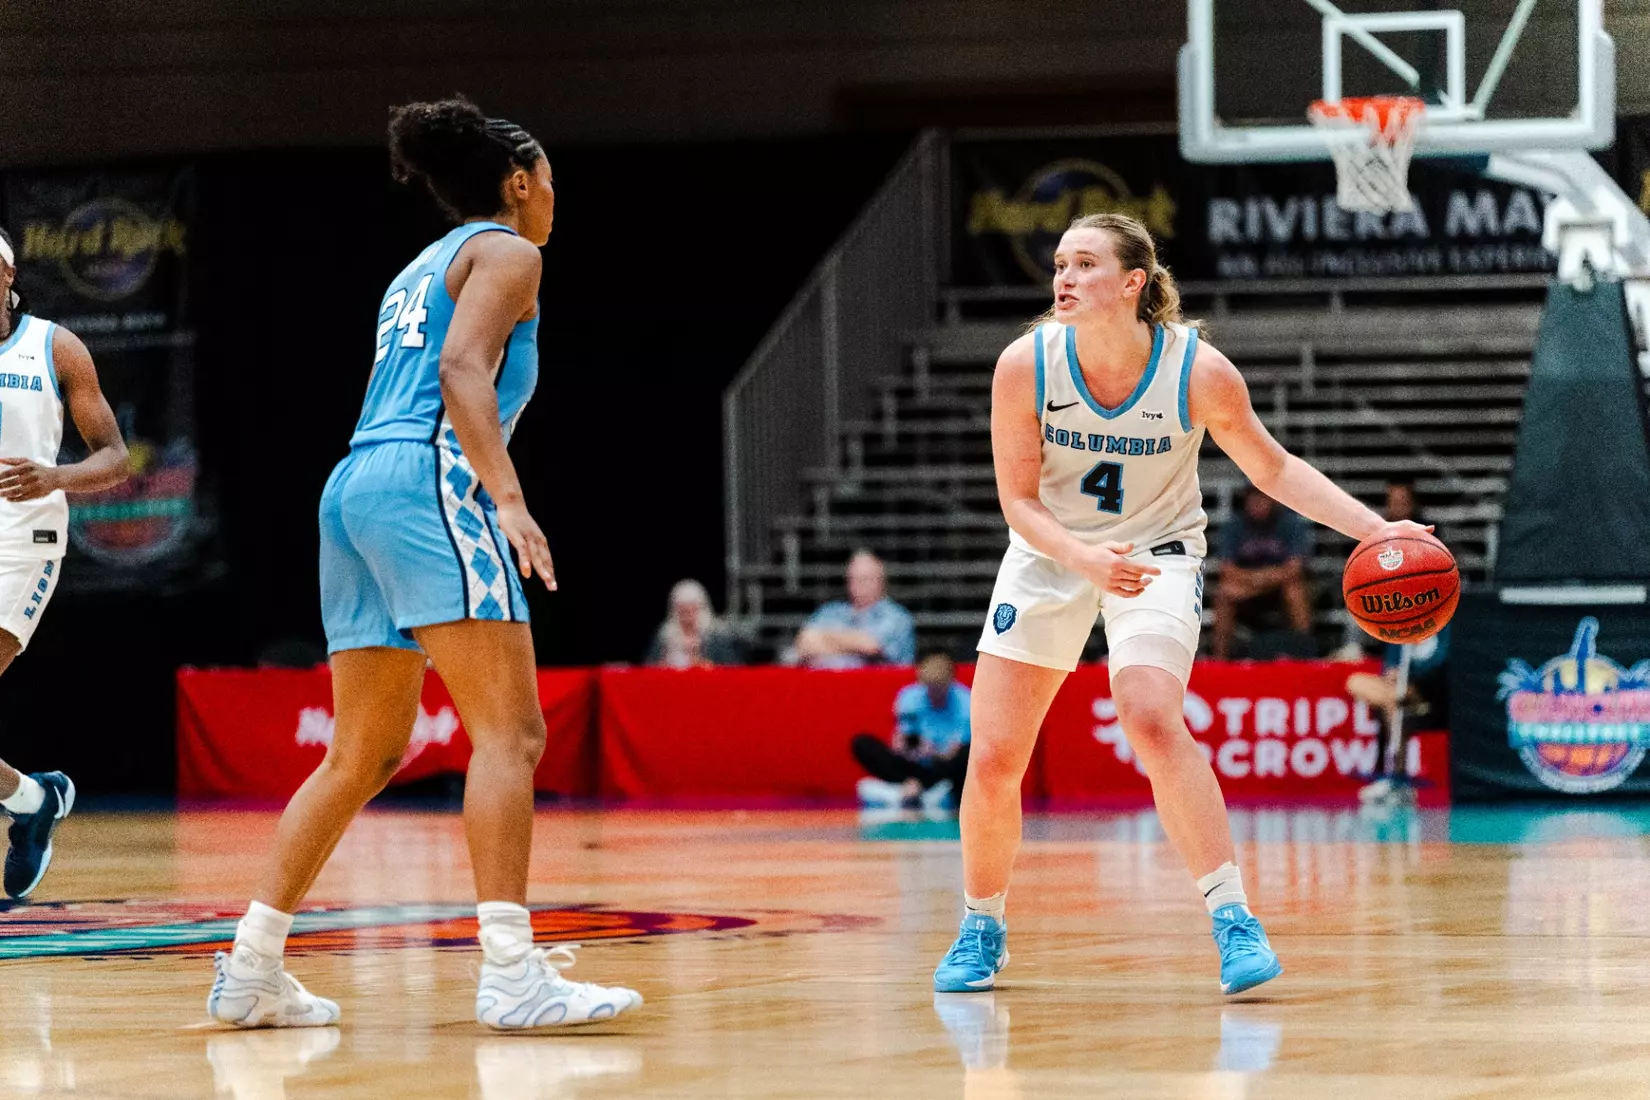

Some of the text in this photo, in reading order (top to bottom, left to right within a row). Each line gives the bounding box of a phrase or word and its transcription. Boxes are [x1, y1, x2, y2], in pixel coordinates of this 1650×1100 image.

[1208, 194, 1430, 242] RIVIERA
[1445, 189, 1547, 237] MA
[375, 272, 435, 364] 24
[1141, 410, 1156, 421] Ivy
[1045, 422, 1172, 456] COLUMBIA
[1080, 460, 1124, 515] 4
[1360, 587, 1441, 614] Wilson
[1216, 696, 1381, 738] TRIPL
